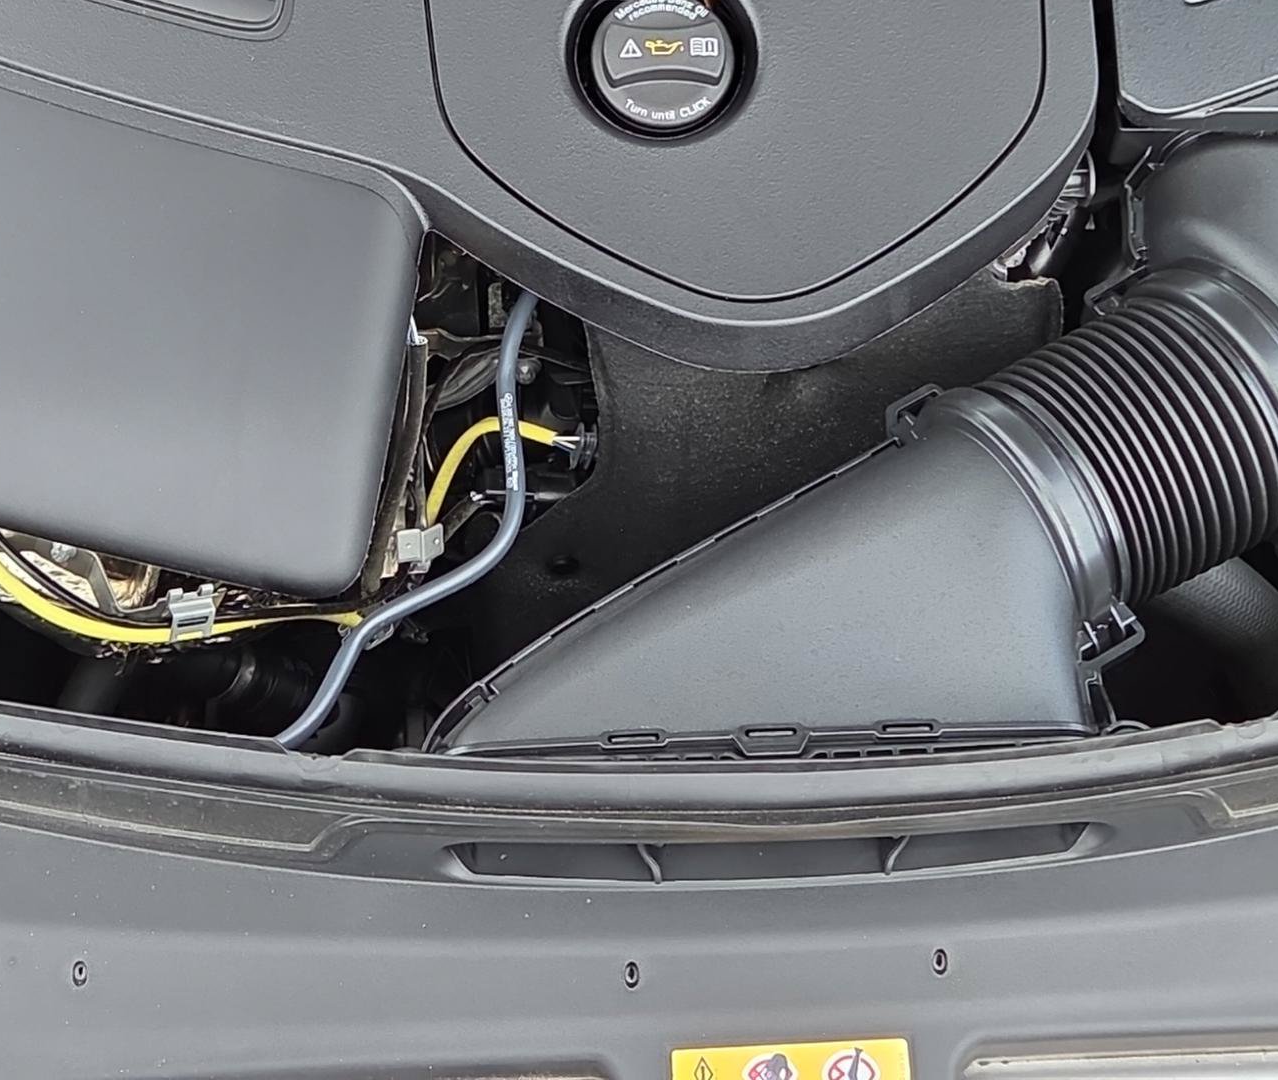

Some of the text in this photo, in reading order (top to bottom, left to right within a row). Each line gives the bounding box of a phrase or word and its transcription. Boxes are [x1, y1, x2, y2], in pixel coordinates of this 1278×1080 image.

[628, 3, 697, 22] recommended
[695, 4, 709, 18] Oil
[625, 96, 712, 120] Turn until CLICK
